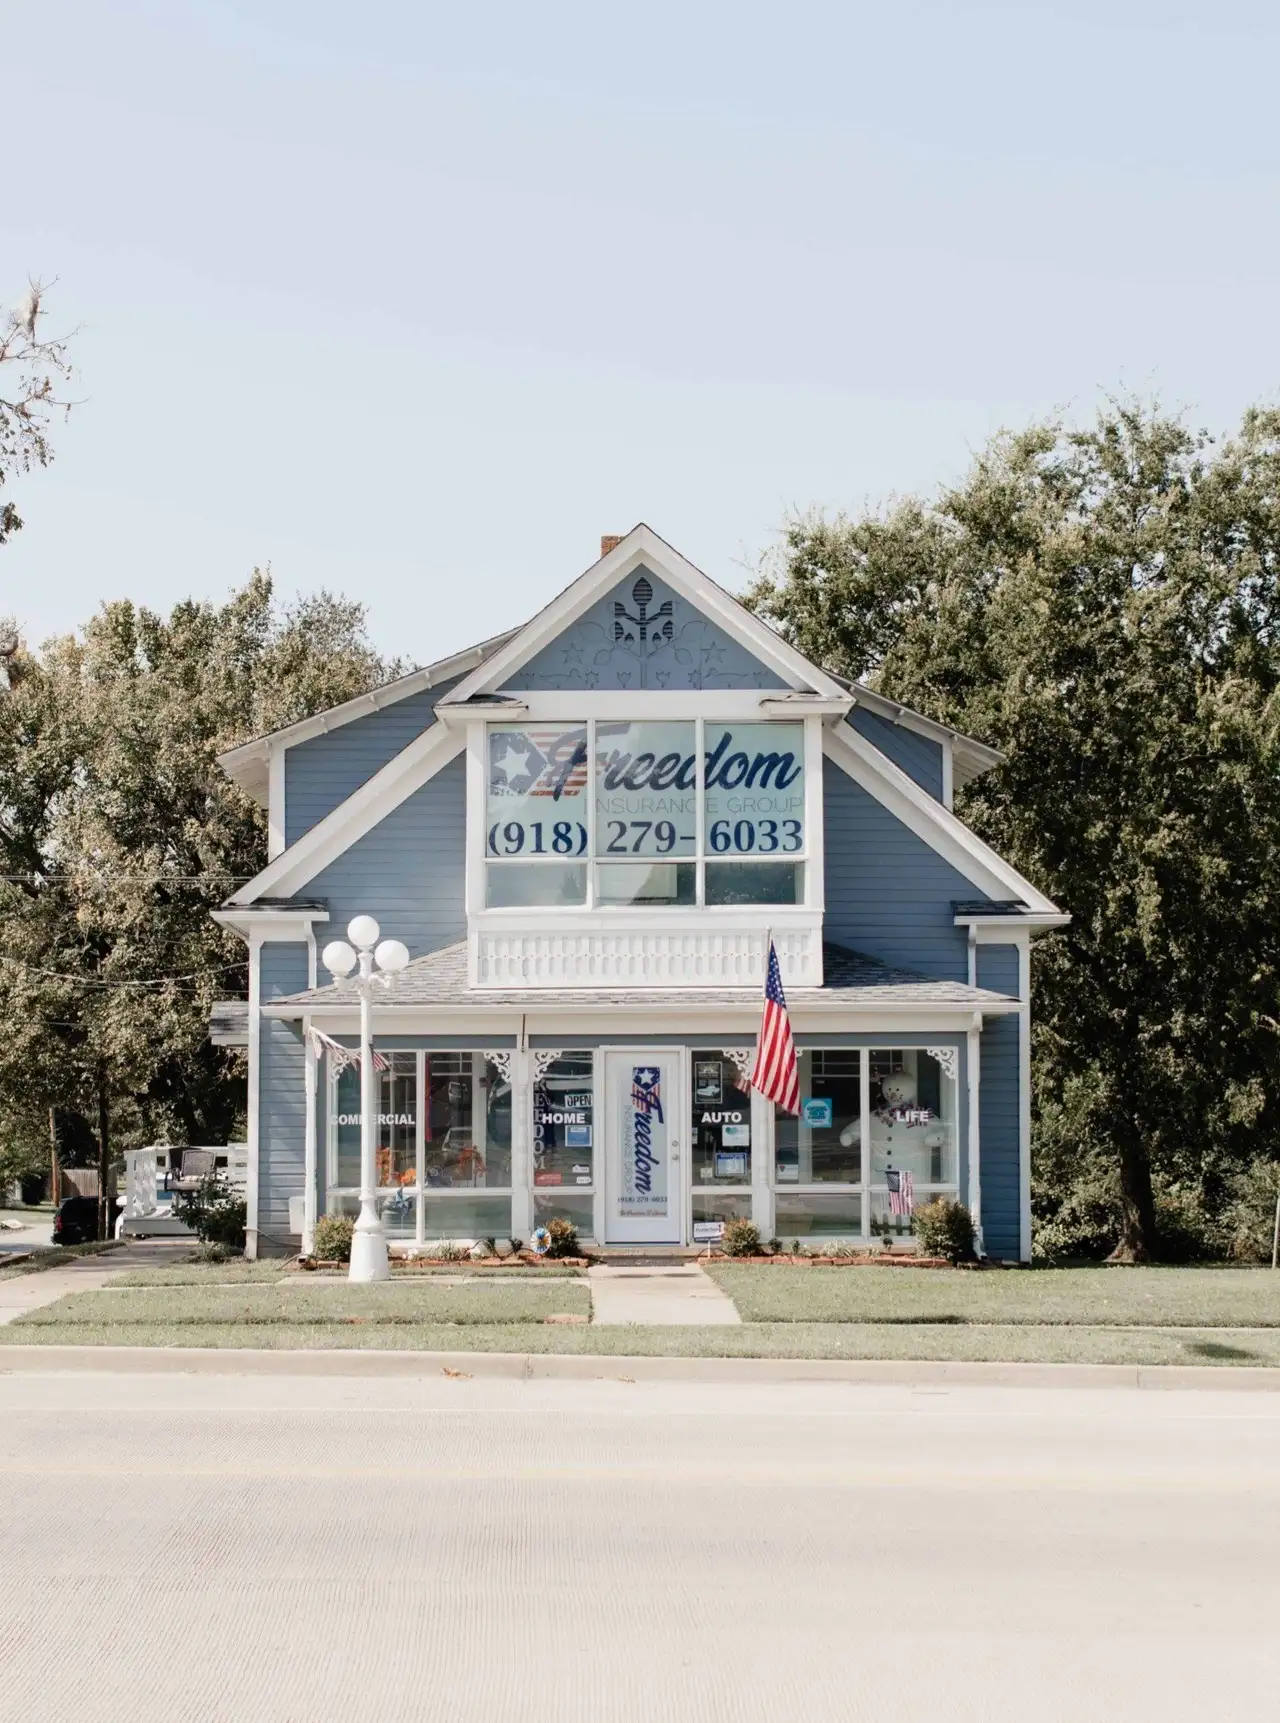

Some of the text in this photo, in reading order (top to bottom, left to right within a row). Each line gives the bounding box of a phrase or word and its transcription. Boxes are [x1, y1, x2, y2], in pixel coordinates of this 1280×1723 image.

[546, 722, 801, 801] Freedom
[583, 797, 803, 814] INSURANCE GROUP
[489, 821, 588, 855] (918)
[567, 1094, 592, 1107] OPEN
[330, 1113, 415, 1125] COMERCIAL
[542, 1113, 585, 1124] HOME
[701, 1111, 742, 1123] AUTO
[896, 1110, 929, 1122] LIFE
[630, 1090, 664, 1195] Freedom
